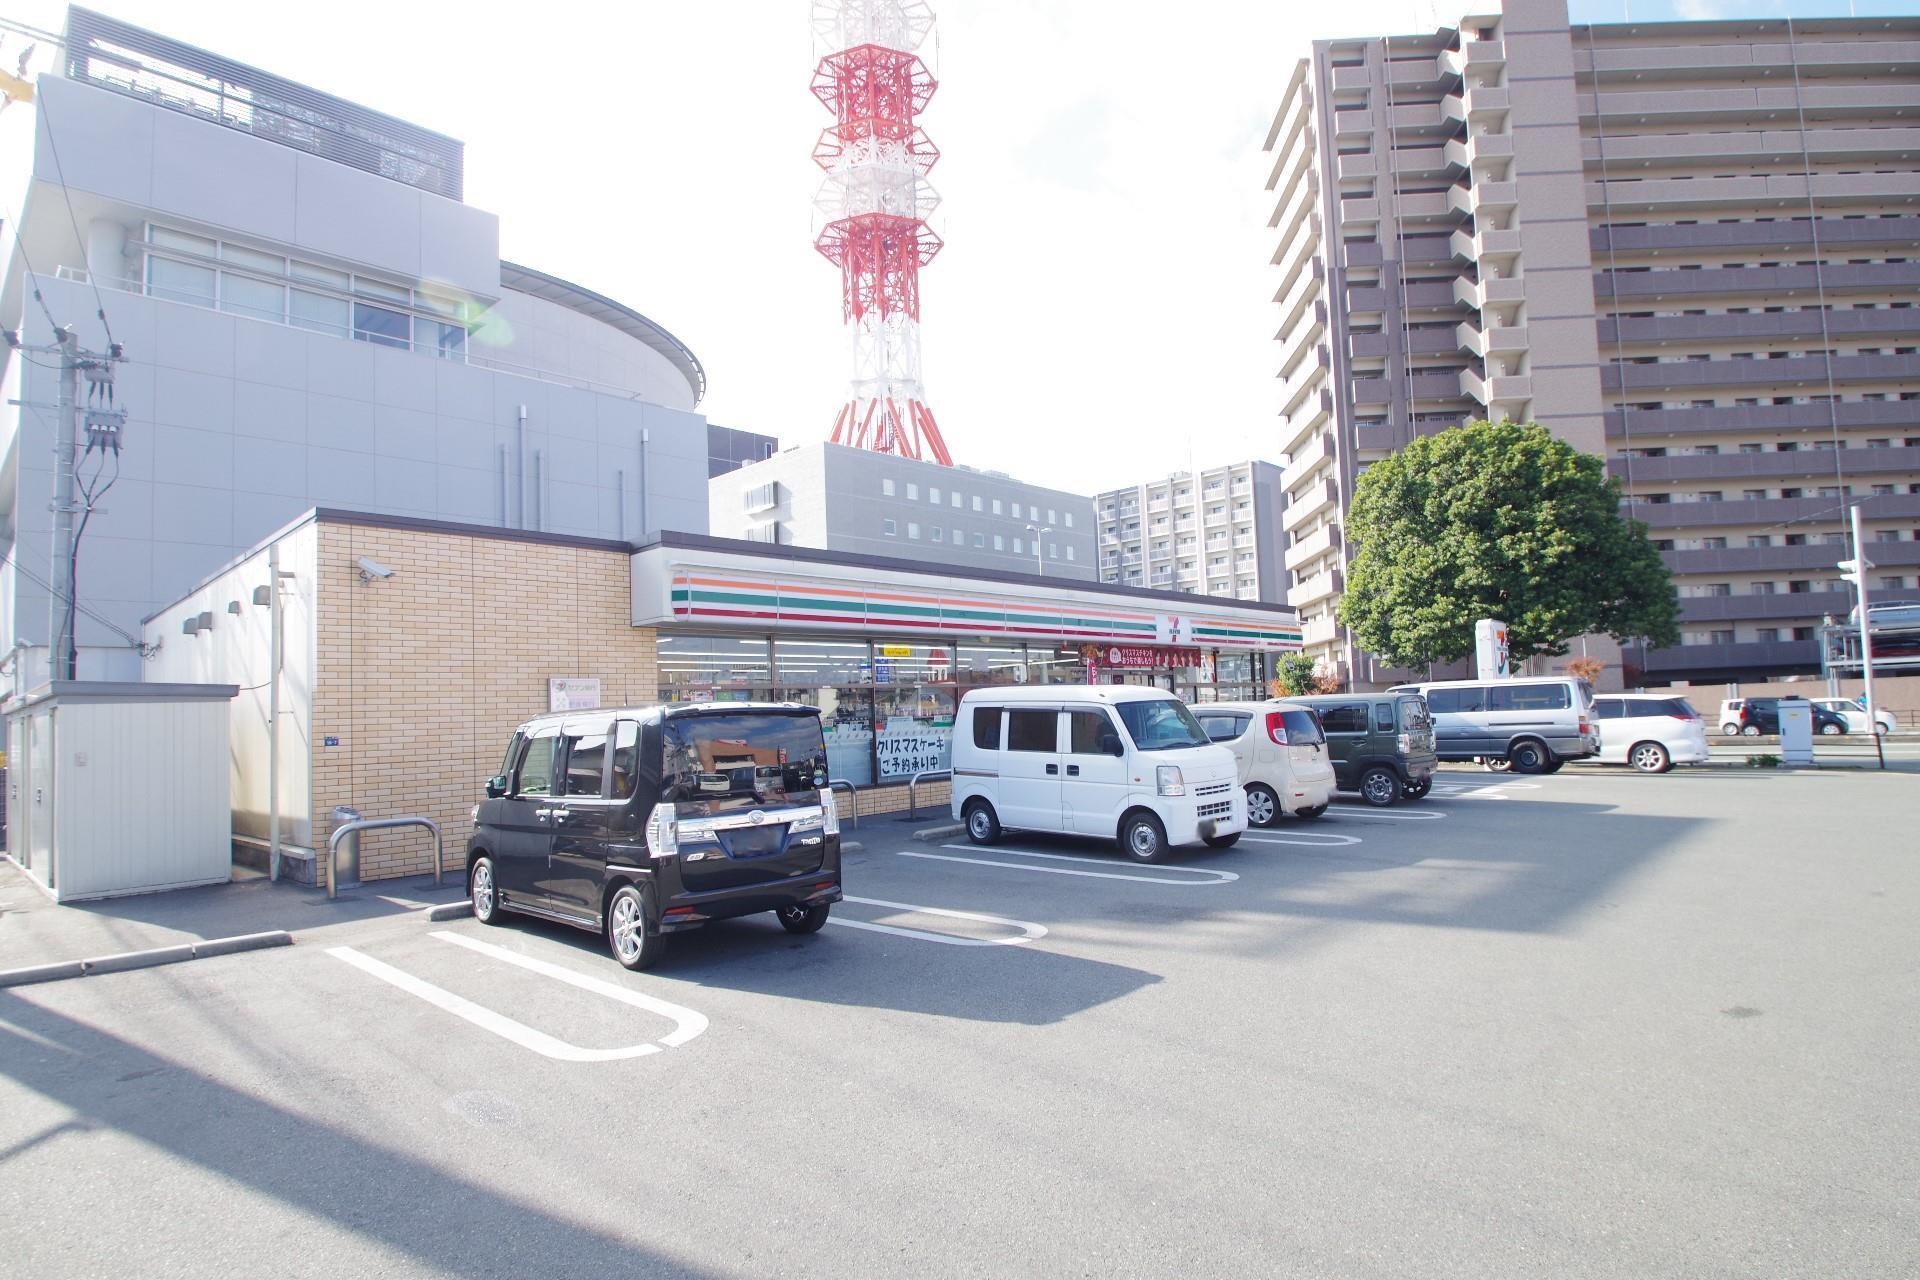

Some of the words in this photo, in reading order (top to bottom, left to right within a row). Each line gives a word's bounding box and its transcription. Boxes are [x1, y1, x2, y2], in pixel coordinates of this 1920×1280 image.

[877, 736, 944, 755] クリスマスケーキ
[882, 755, 938, 774] ご予約承り中
